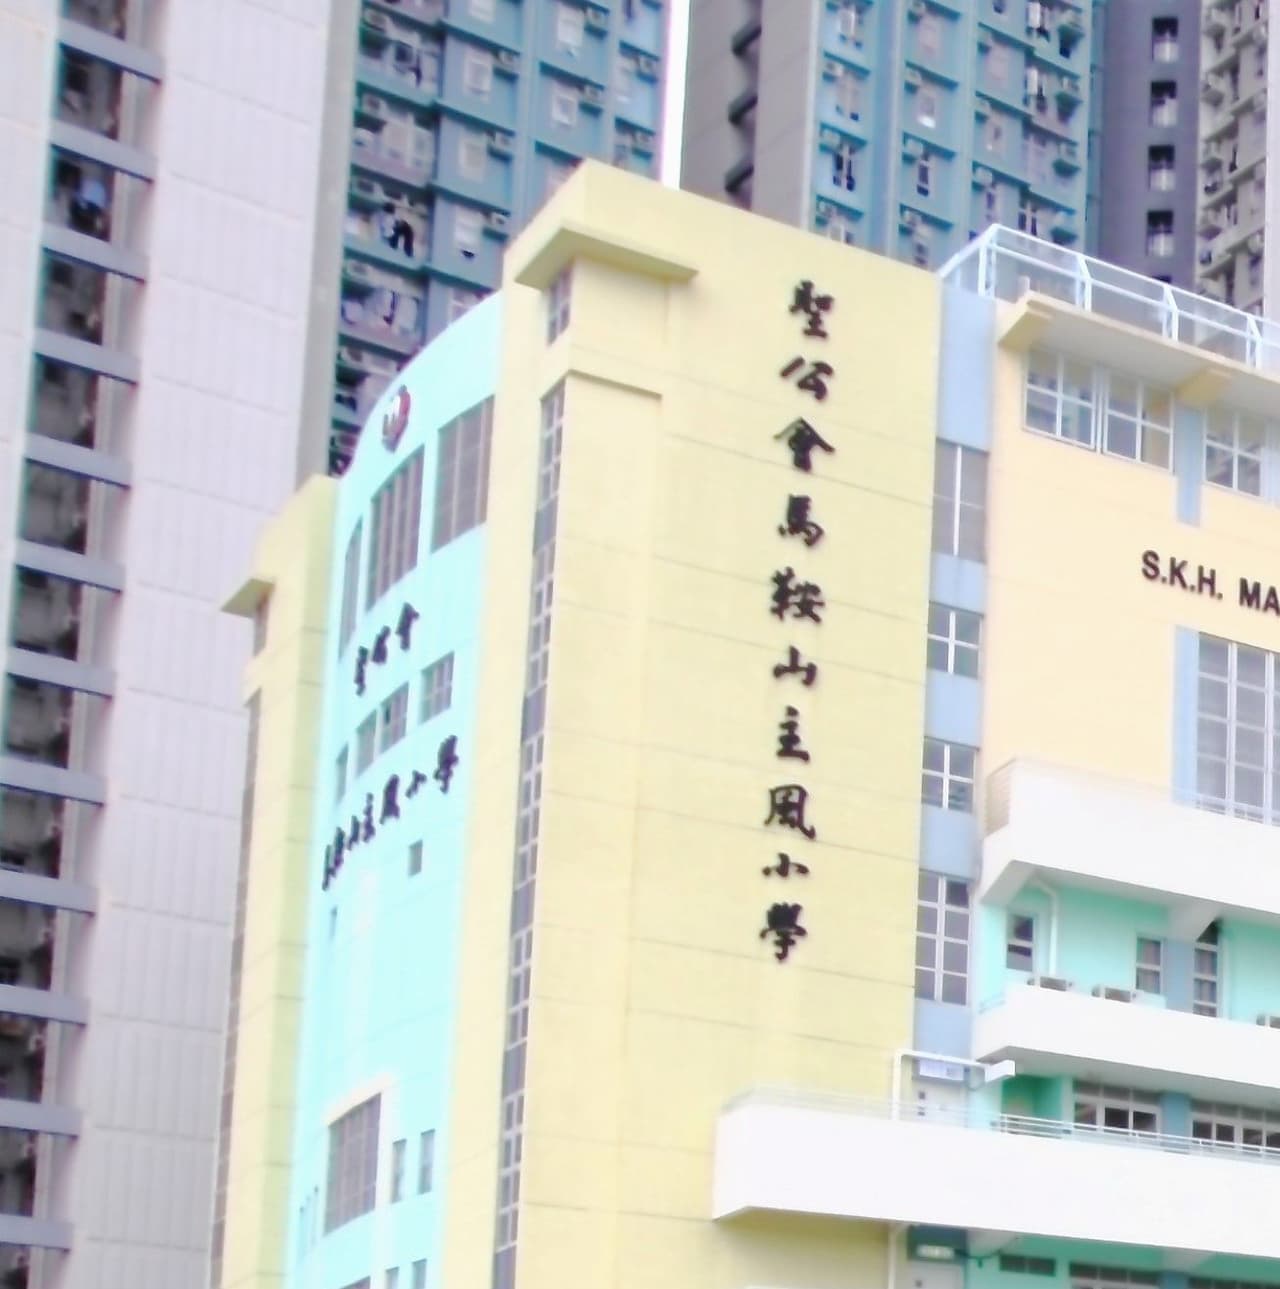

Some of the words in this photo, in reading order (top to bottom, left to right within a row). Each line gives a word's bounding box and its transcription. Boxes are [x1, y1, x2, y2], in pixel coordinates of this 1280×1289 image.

[759, 280, 836, 963] 聖公會馬鞍山主風小學
[1141, 550, 1223, 600] S.K.H.
[1239, 578, 1280, 616] MA
